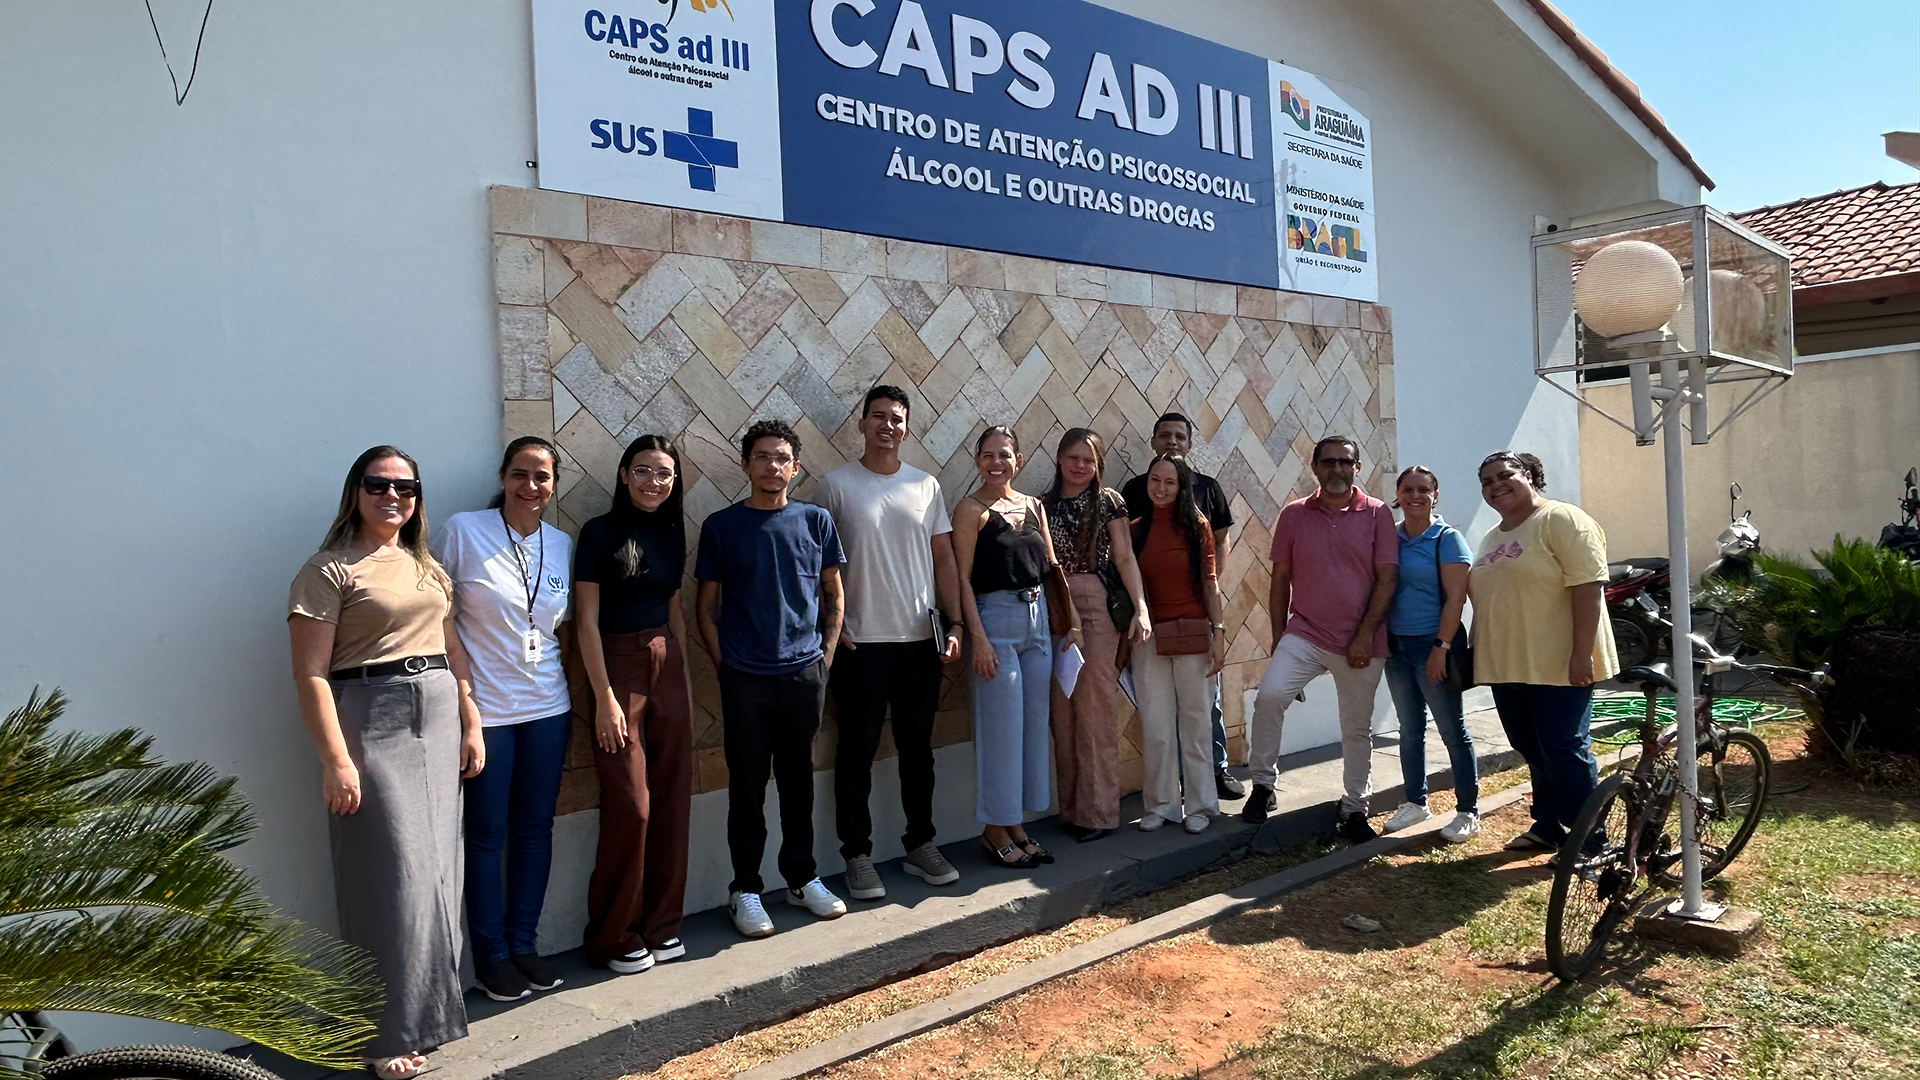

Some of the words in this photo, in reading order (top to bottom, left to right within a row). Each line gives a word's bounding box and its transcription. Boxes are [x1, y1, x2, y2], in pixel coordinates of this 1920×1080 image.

[584, 9, 669, 54] CAPS
[678, 35, 713, 64] ad
[722, 38, 750, 71] III
[609, 49, 636, 63] Centro
[638, 55, 648, 65] de
[649, 57, 681, 72] Atenção
[683, 63, 729, 80] Psicossocial
[628, 65, 653, 78] álcool
[654, 71, 659, 79] e
[660, 72, 685, 84] outras
[686, 76, 713, 89] drogas
[810, 0, 1055, 109] CAPS
[1076, 51, 1179, 136] AD
[1198, 83, 1253, 159] III
[590, 118, 657, 156] SUS
[1314, 113, 1365, 142] ARAGUAÍNA
[816, 93, 936, 139] CENTRO
[943, 118, 980, 148] DE
[987, 128, 1104, 171] ATENÇÃO
[1108, 152, 1256, 204] PSICOSSOCIAL
[1287, 141, 1329, 160] SECRETARIA
[1330, 152, 1340, 163] DA
[1341, 155, 1363, 169] SAÚDE
[885, 146, 1000, 194] ÁLCOOL
[1004, 173, 1022, 198] E
[1027, 177, 1124, 215] OUTRAS
[1128, 195, 1215, 231] DROGAS
[1286, 184, 1328, 202] MINISTÉRIO
[1329, 194, 1340, 205] DA
[1341, 197, 1365, 210] SAÚDE
[1293, 202, 1328, 216] GOVERNO
[1329, 210, 1360, 223] FEDERAL
[1287, 214, 1367, 263] BRASIL
[1320, 260, 1362, 273] RECONSTRUÇÃO
